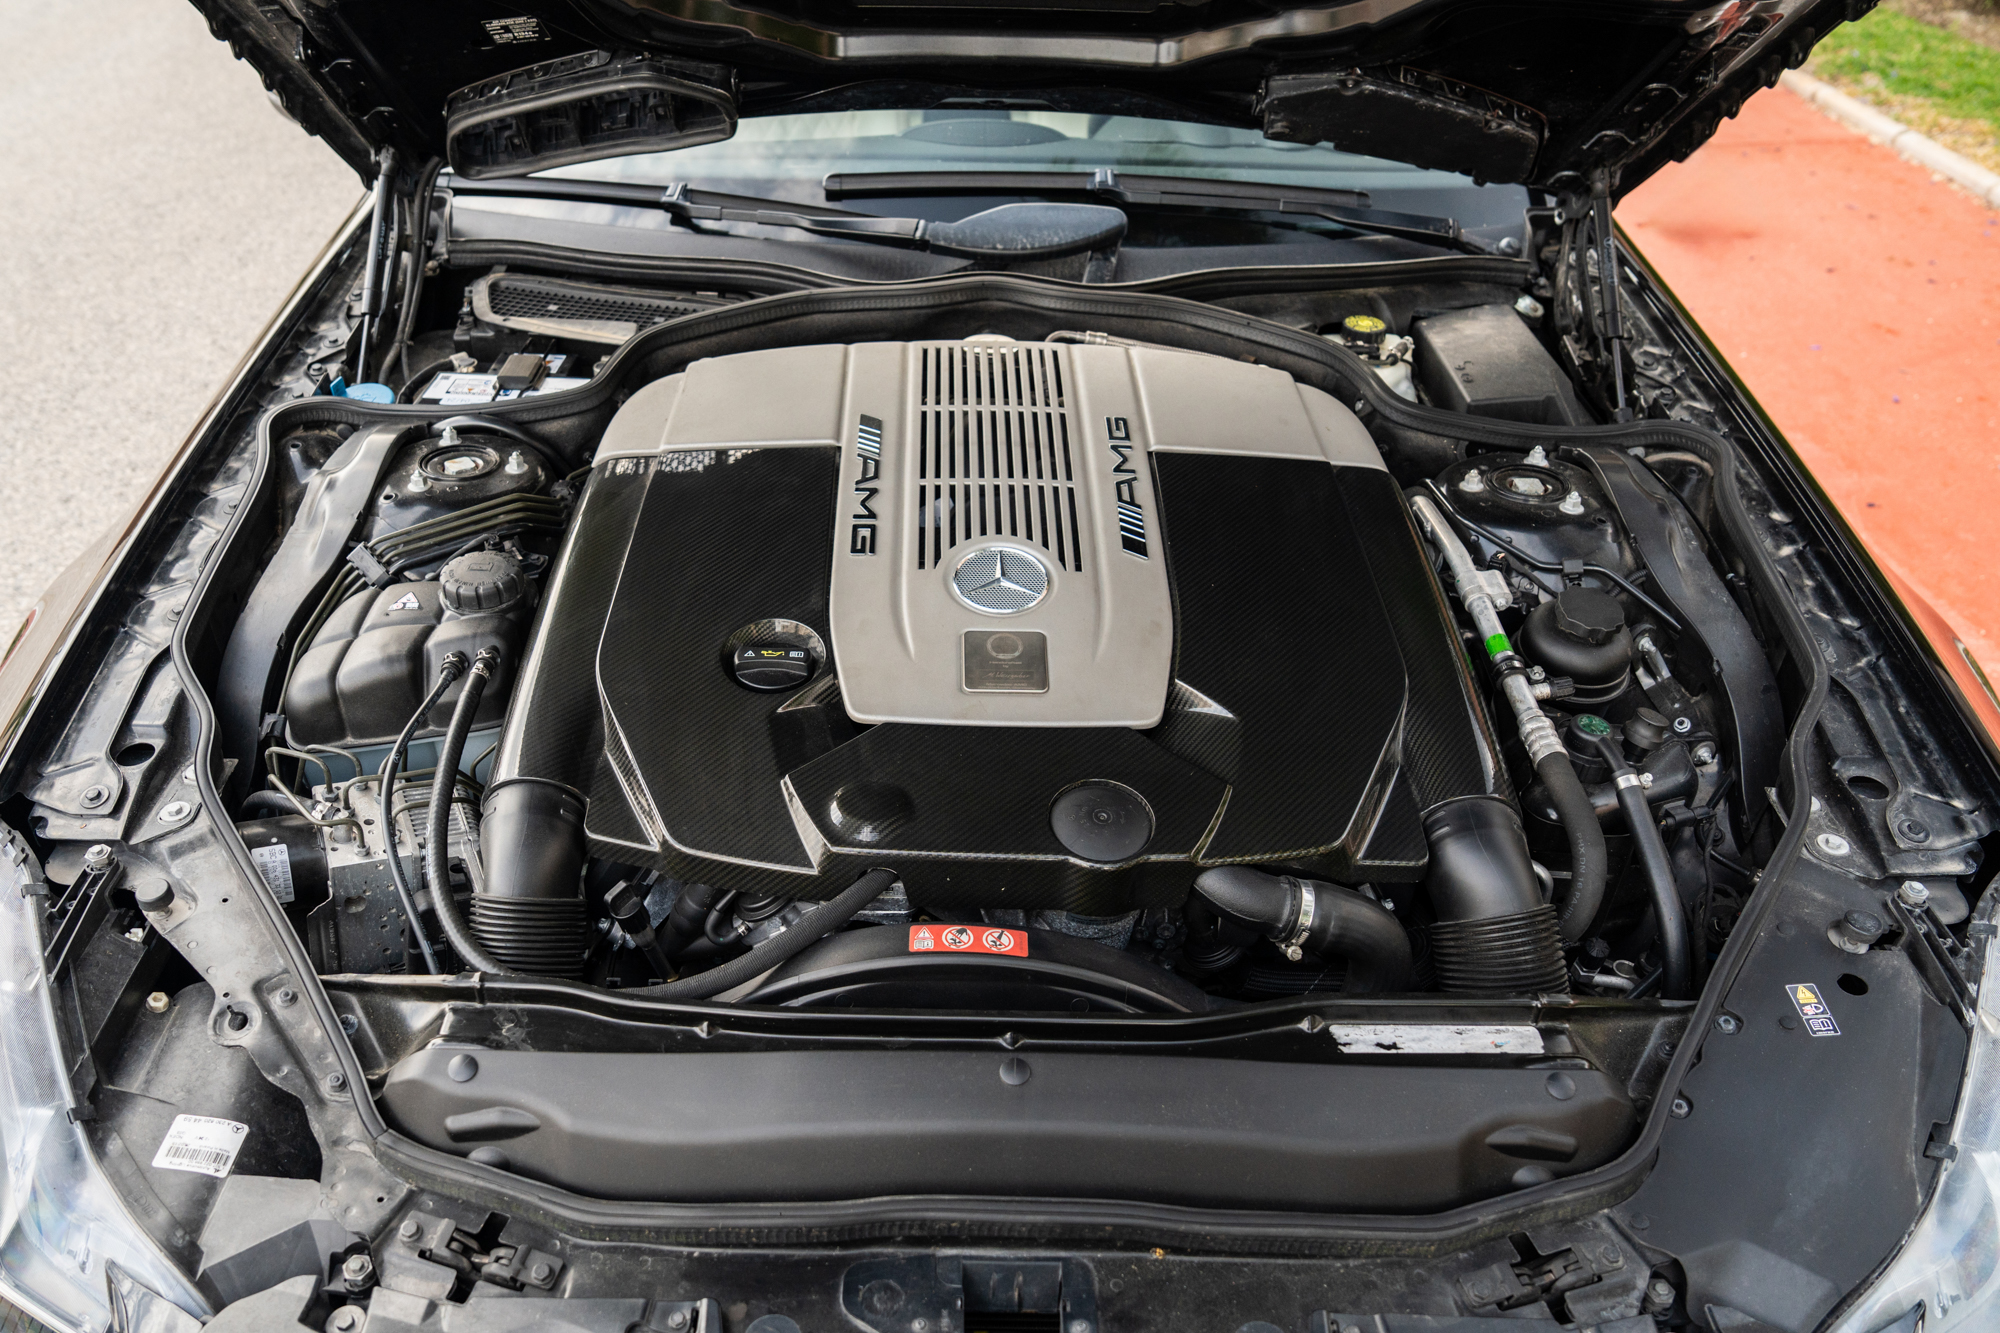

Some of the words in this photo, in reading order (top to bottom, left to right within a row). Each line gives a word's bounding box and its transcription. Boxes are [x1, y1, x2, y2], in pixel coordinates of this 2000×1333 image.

[1104, 416, 1142, 511] AMG
[850, 452, 880, 556] AMG
[269, 848, 277, 860] SBC
[1580, 857, 1586, 873] DN
